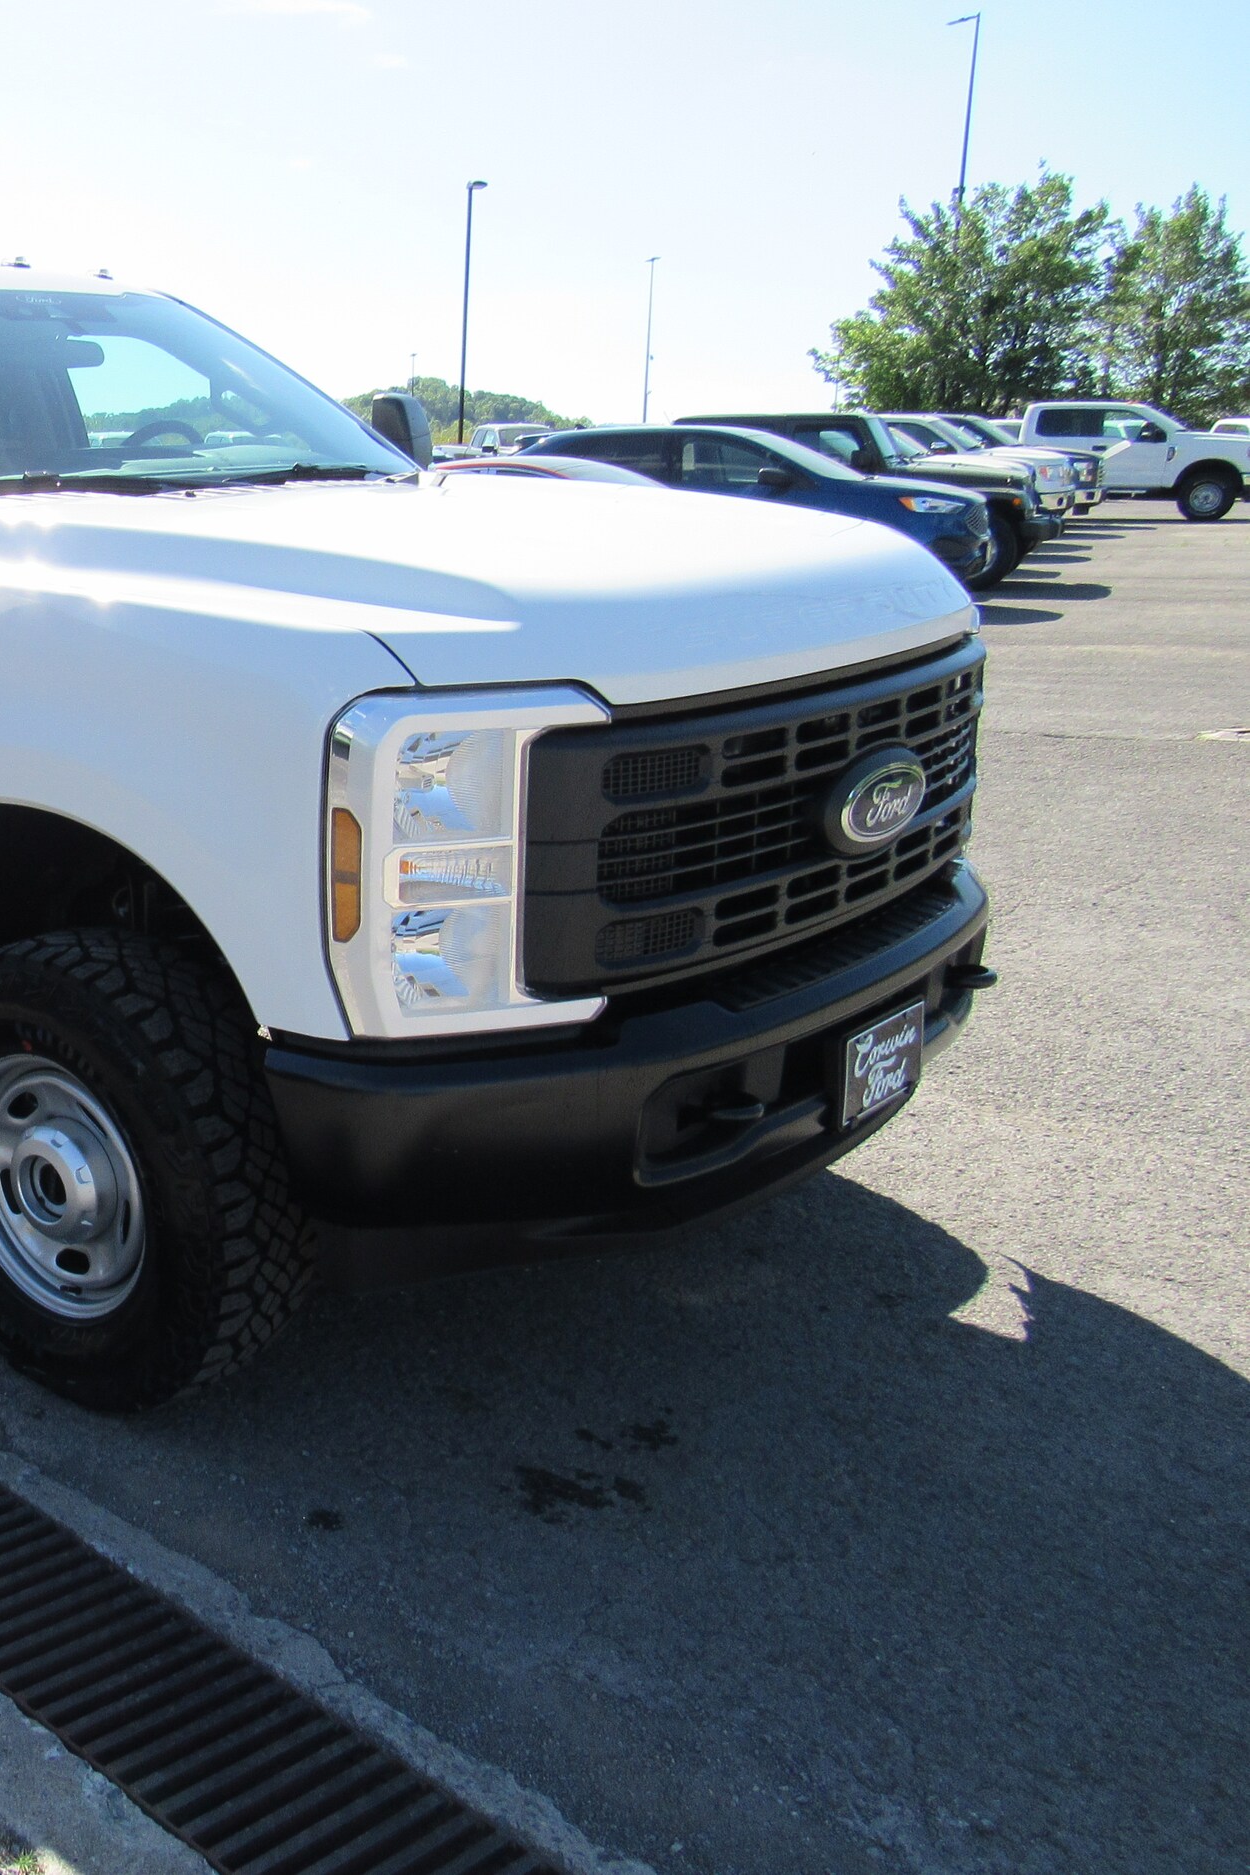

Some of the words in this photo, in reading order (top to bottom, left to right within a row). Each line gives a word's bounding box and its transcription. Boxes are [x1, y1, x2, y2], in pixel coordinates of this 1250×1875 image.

[865, 778, 913, 828] Ford
[854, 1023, 917, 1079] Corwin
[862, 1054, 908, 1109] Ford
